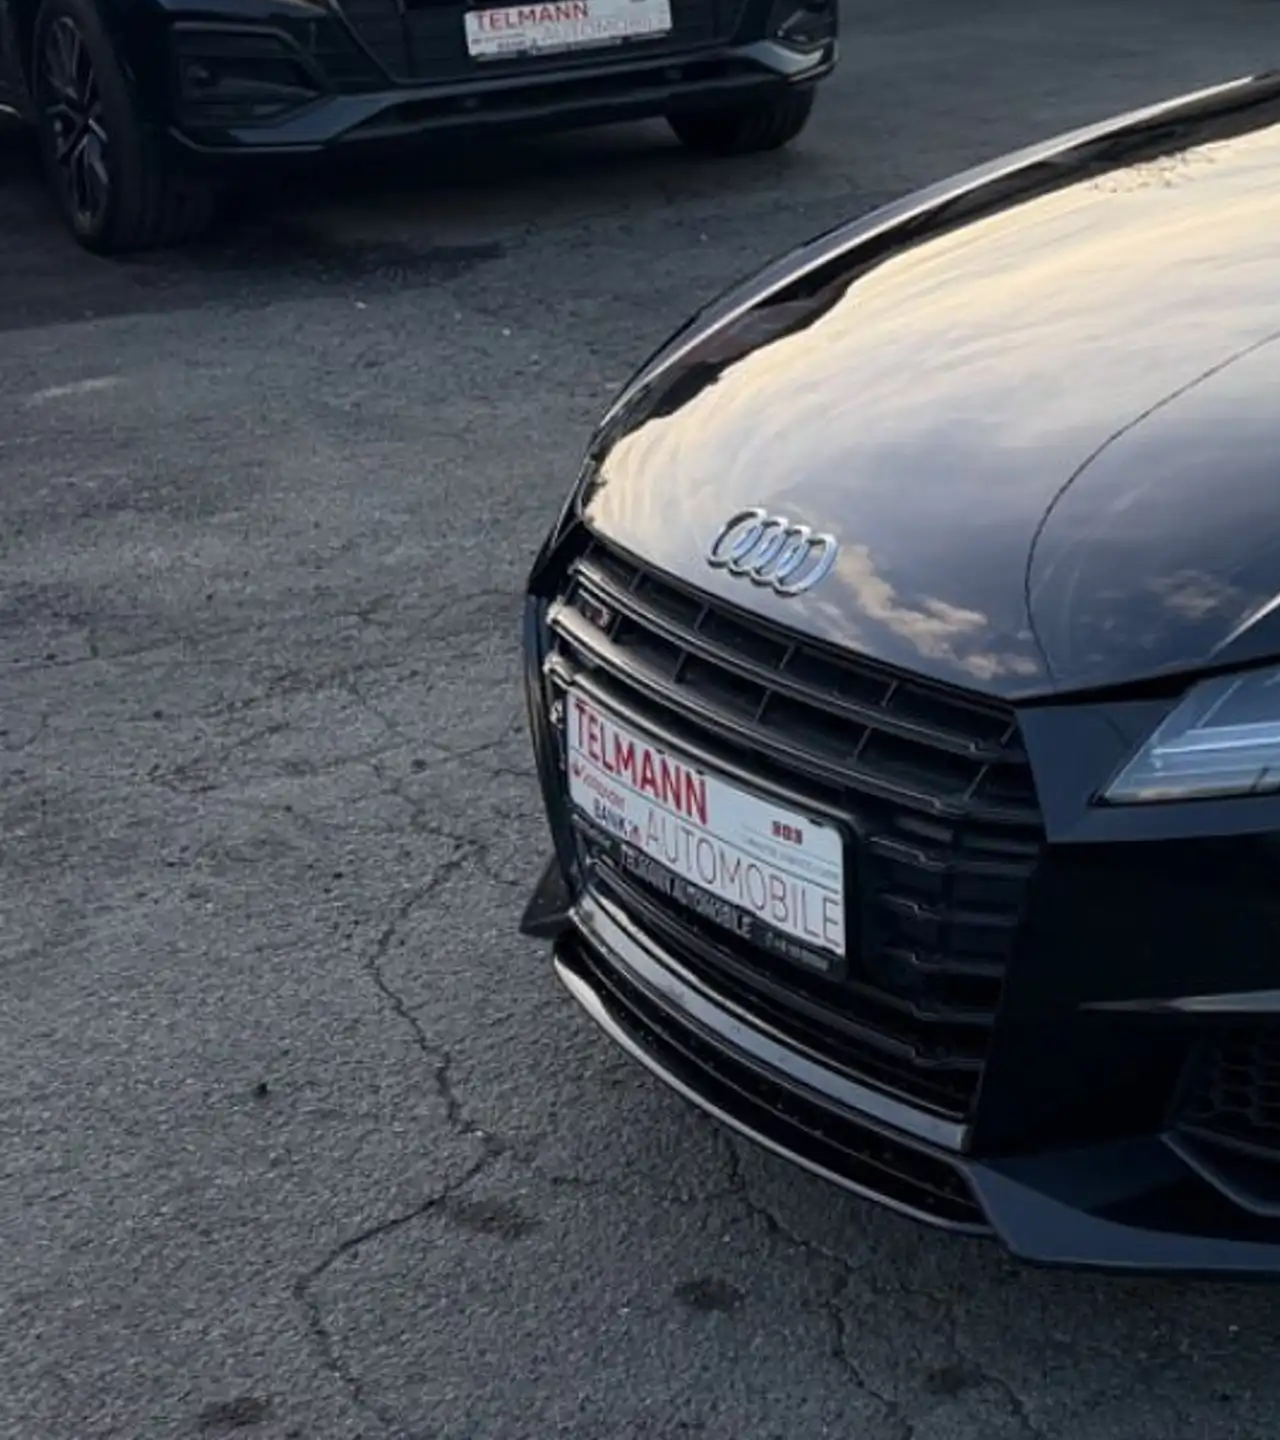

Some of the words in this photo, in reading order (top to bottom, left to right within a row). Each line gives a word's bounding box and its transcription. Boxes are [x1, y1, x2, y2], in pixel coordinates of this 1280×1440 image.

[477, 2, 589, 31] TELMANN
[574, 698, 707, 827] TELMANN
[645, 806, 842, 950] AUTOMOBILE
